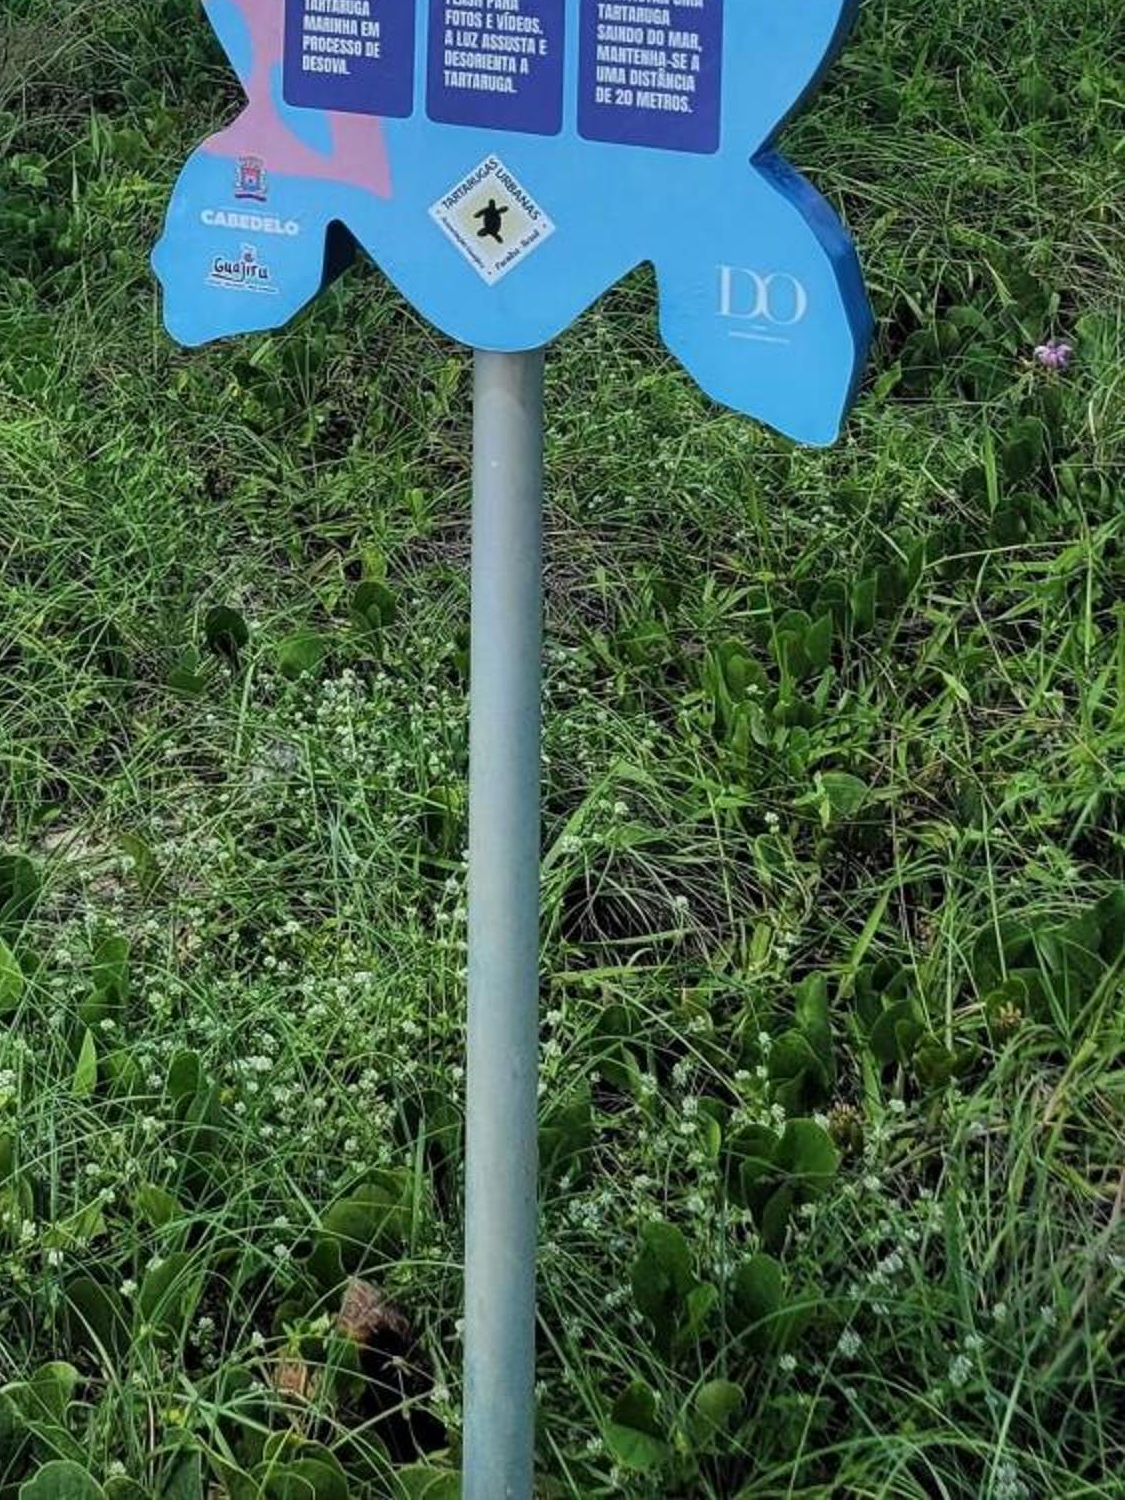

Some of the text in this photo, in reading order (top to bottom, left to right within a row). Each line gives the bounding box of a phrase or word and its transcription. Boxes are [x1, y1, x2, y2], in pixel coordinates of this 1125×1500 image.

[303, 15, 380, 38] MARINHA EM
[445, 9, 544, 35] FOTOS E VÍDEOS.
[597, 3, 670, 26] TARTARUGA
[303, 35, 380, 58] PROCESSO DE
[444, 29, 547, 55] A LUZ ASSUSTA E
[596, 24, 643, 44] SAINDO
[646, 28, 664, 46] DO
[302, 55, 351, 75] DESOVA.
[444, 50, 529, 74] DESORIENTA A
[596, 44, 700, 72] MANTENHA-SE A
[443, 70, 518, 93] TARTARUGA.
[596, 65, 695, 92] UMA DISTÂNCIA
[596, 86, 693, 114] DE 20 METROS.
[441, 158, 542, 220] TARTARUGAS URBANAS
[200, 208, 299, 235] CABEDELO
